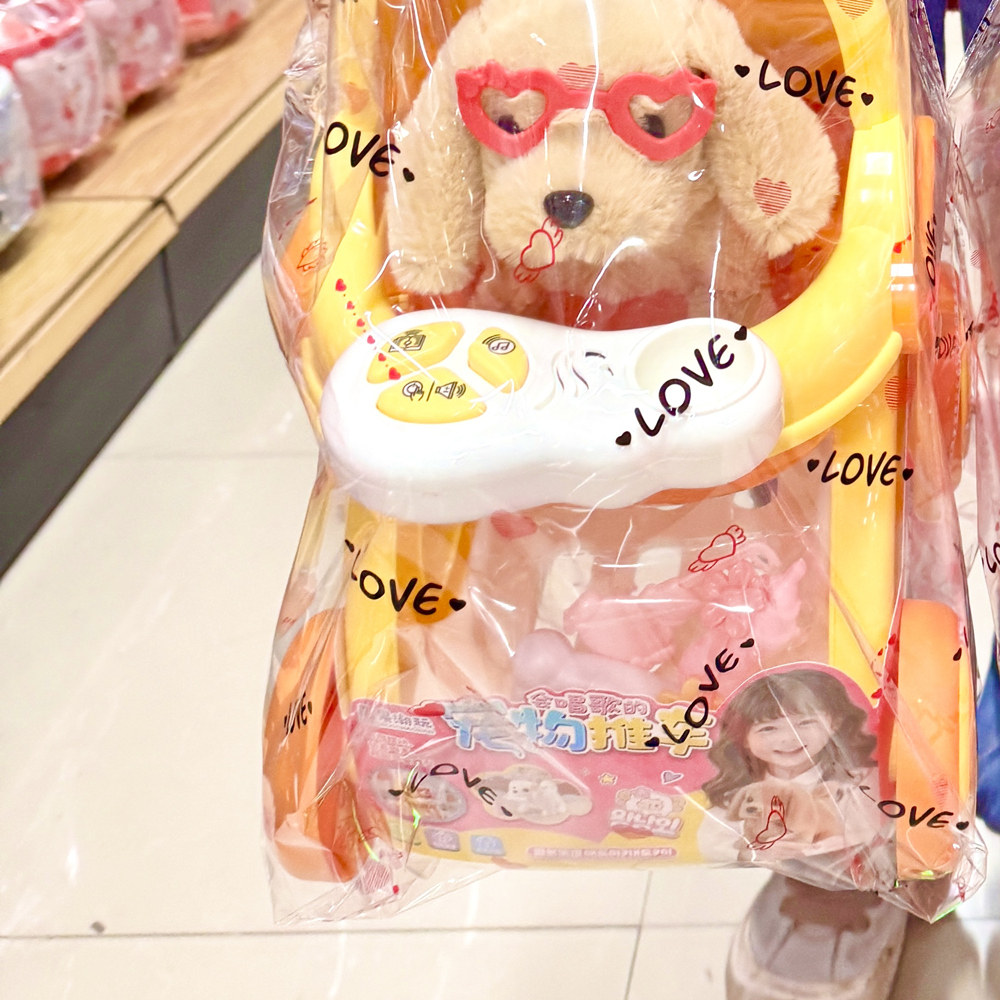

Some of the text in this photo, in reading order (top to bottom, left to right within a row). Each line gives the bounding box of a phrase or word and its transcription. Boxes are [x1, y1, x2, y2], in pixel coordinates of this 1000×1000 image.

[758, 58, 856, 107] LOVE
[634, 333, 735, 437] LOVE
[821, 452, 901, 486] LOVE
[662, 650, 740, 745] LOVE
